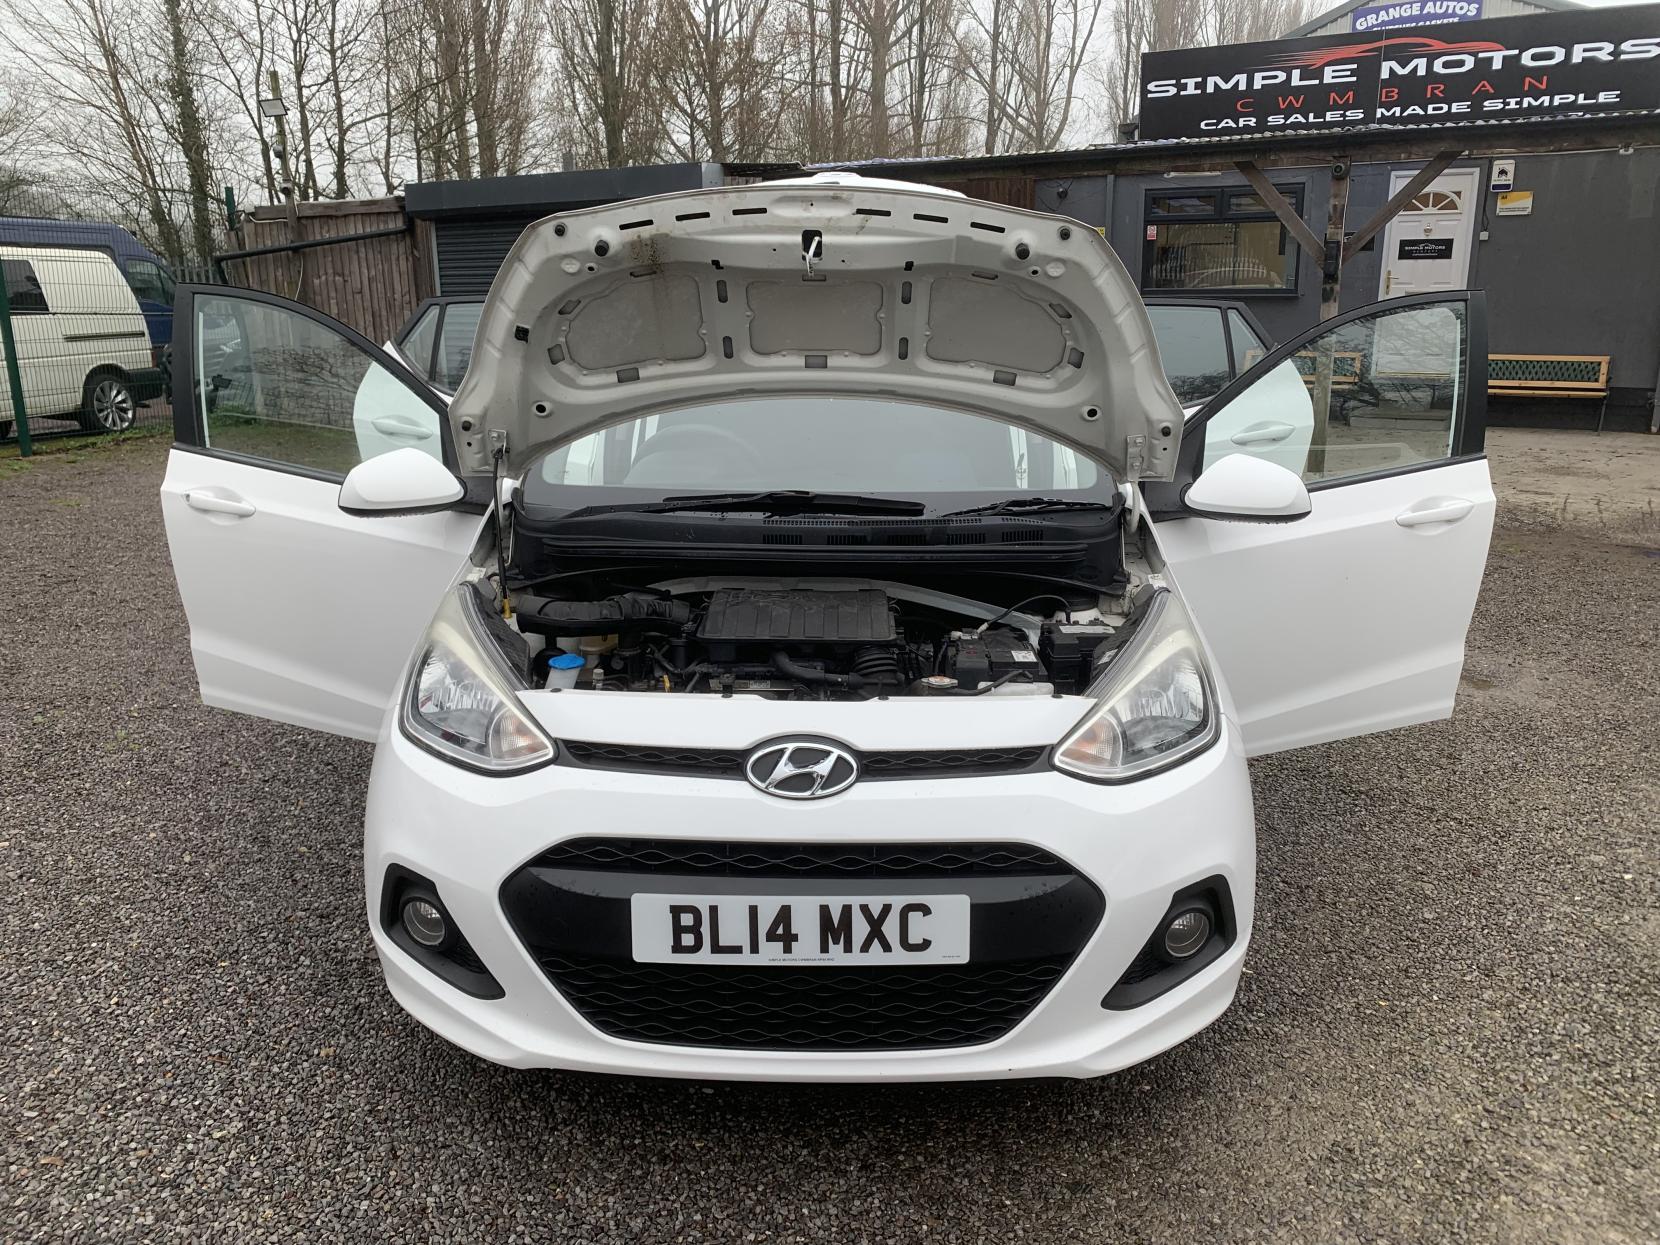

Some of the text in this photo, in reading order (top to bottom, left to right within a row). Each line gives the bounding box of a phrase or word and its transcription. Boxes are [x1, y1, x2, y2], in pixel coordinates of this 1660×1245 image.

[1355, 2, 1421, 30] GRANGE
[1423, 1, 1480, 16] AUTOS
[1147, 38, 1660, 98] SIMPLE MOTORS
[1200, 90, 1621, 130] CAR SALES MADE SIMPLE
[669, 902, 933, 955] BL14 MXC
